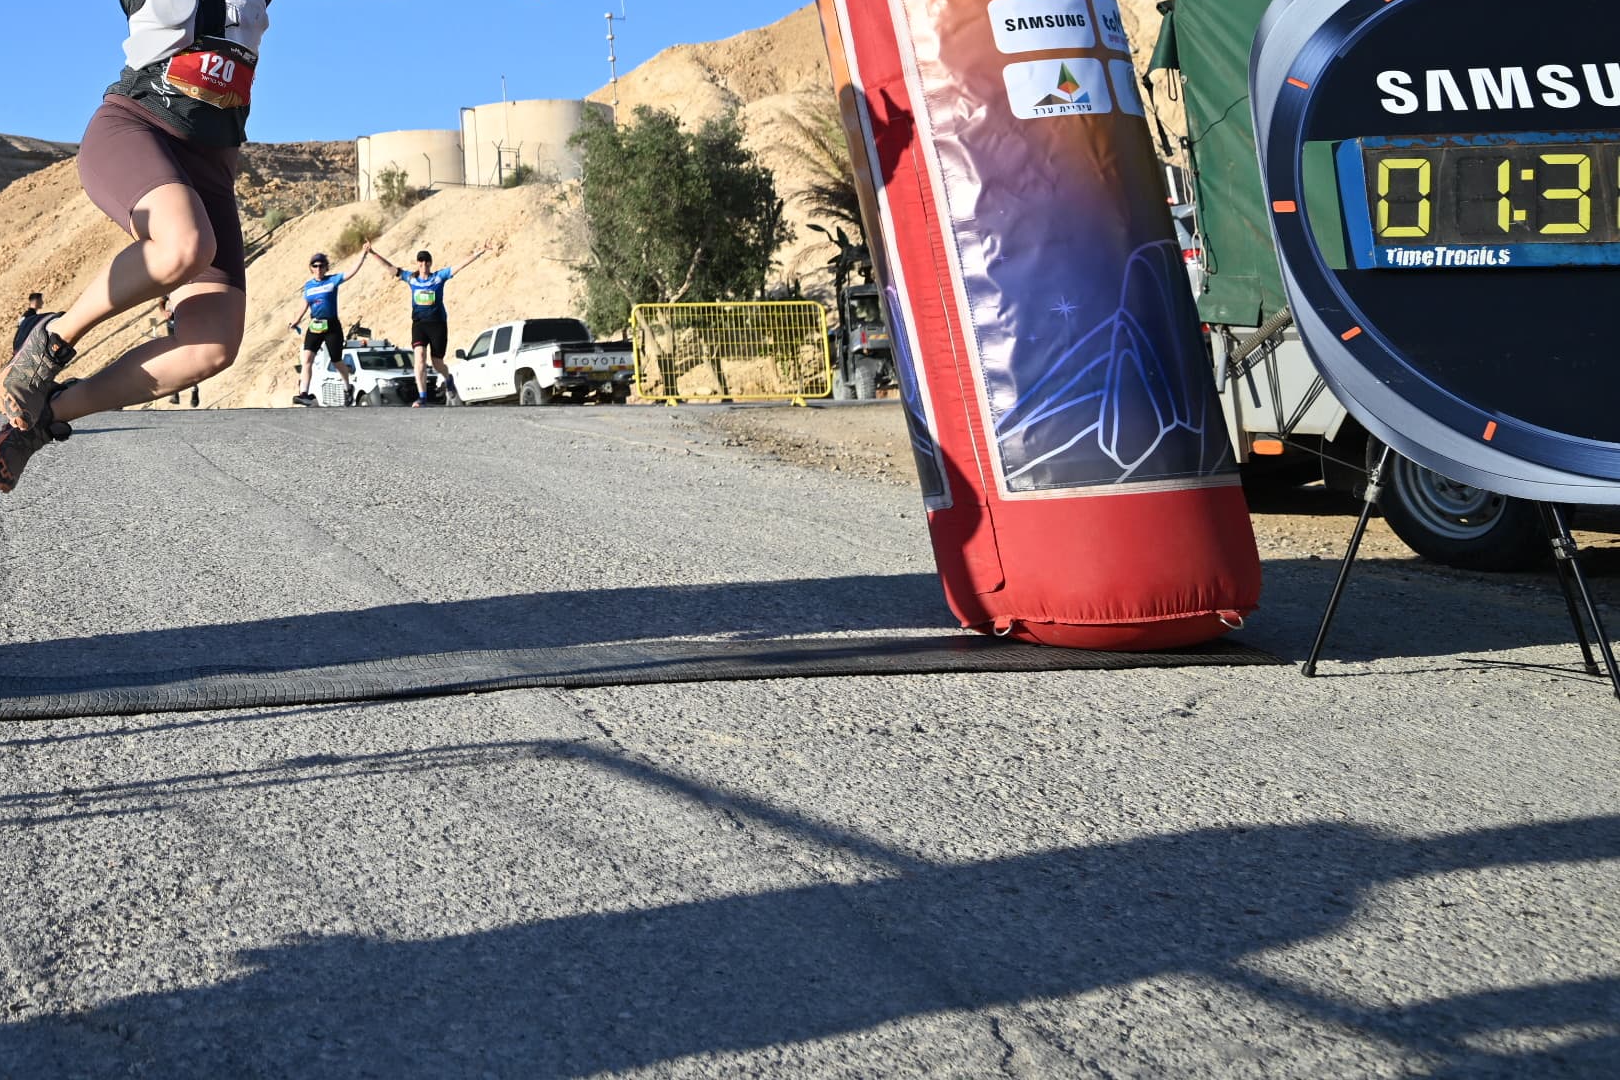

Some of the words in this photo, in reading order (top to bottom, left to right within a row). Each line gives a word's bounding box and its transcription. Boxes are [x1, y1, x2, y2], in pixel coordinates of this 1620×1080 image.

[1004, 13, 1087, 32] SAMSUNG
[200, 53, 236, 83] 120
[1377, 153, 1620, 238] 01:3
[572, 356, 626, 366] TOYOTA
